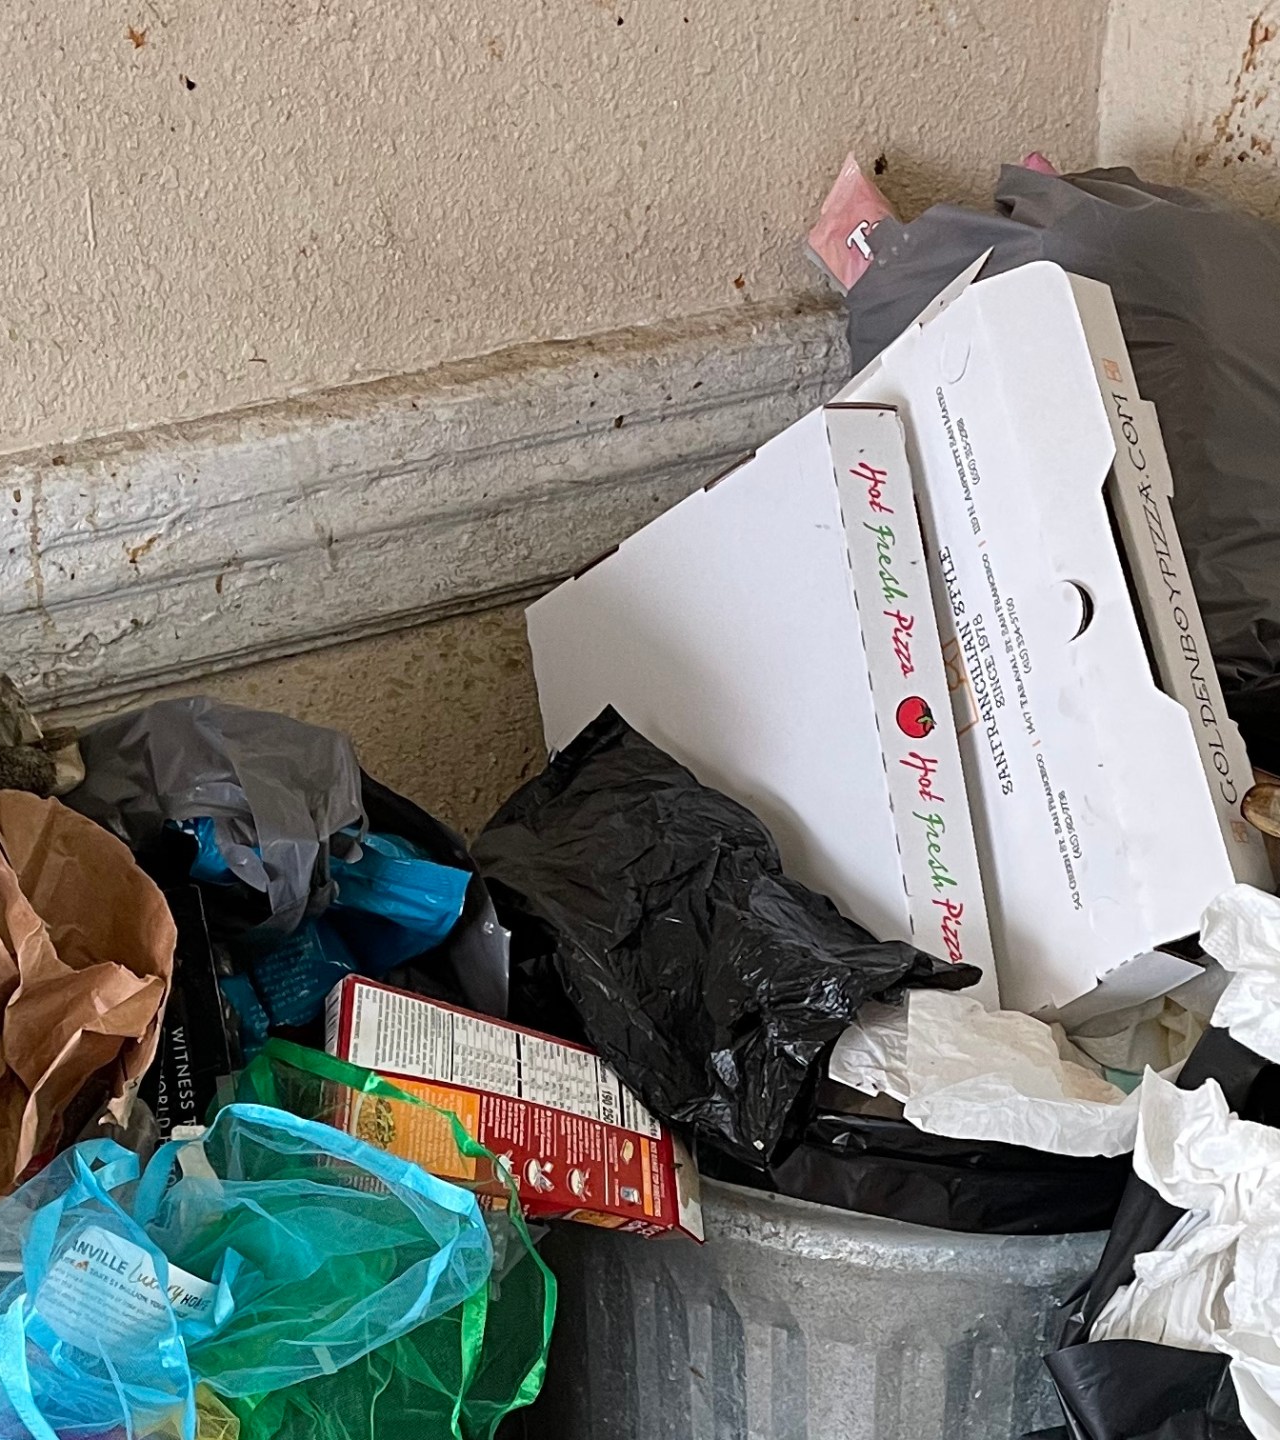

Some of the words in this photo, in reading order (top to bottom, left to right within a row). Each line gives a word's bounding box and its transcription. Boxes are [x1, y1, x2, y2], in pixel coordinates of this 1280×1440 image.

[849, 462, 894, 514] Hot
[863, 521, 908, 604] Fresh
[936, 546, 967, 617] STYLE
[1111, 389, 1239, 807] GOLDENBOYPIZZA.COM
[883, 609, 921, 680] Pizza
[971, 613, 991, 652] 1978
[983, 655, 1007, 709] SINCE
[899, 751, 945, 802] Hot
[912, 811, 957, 893] Fresh
[932, 898, 964, 965] Pizza
[169, 1026, 196, 1110] WITNESS
[600, 1088, 614, 1105] 190
[601, 1106, 616, 1125] 250
